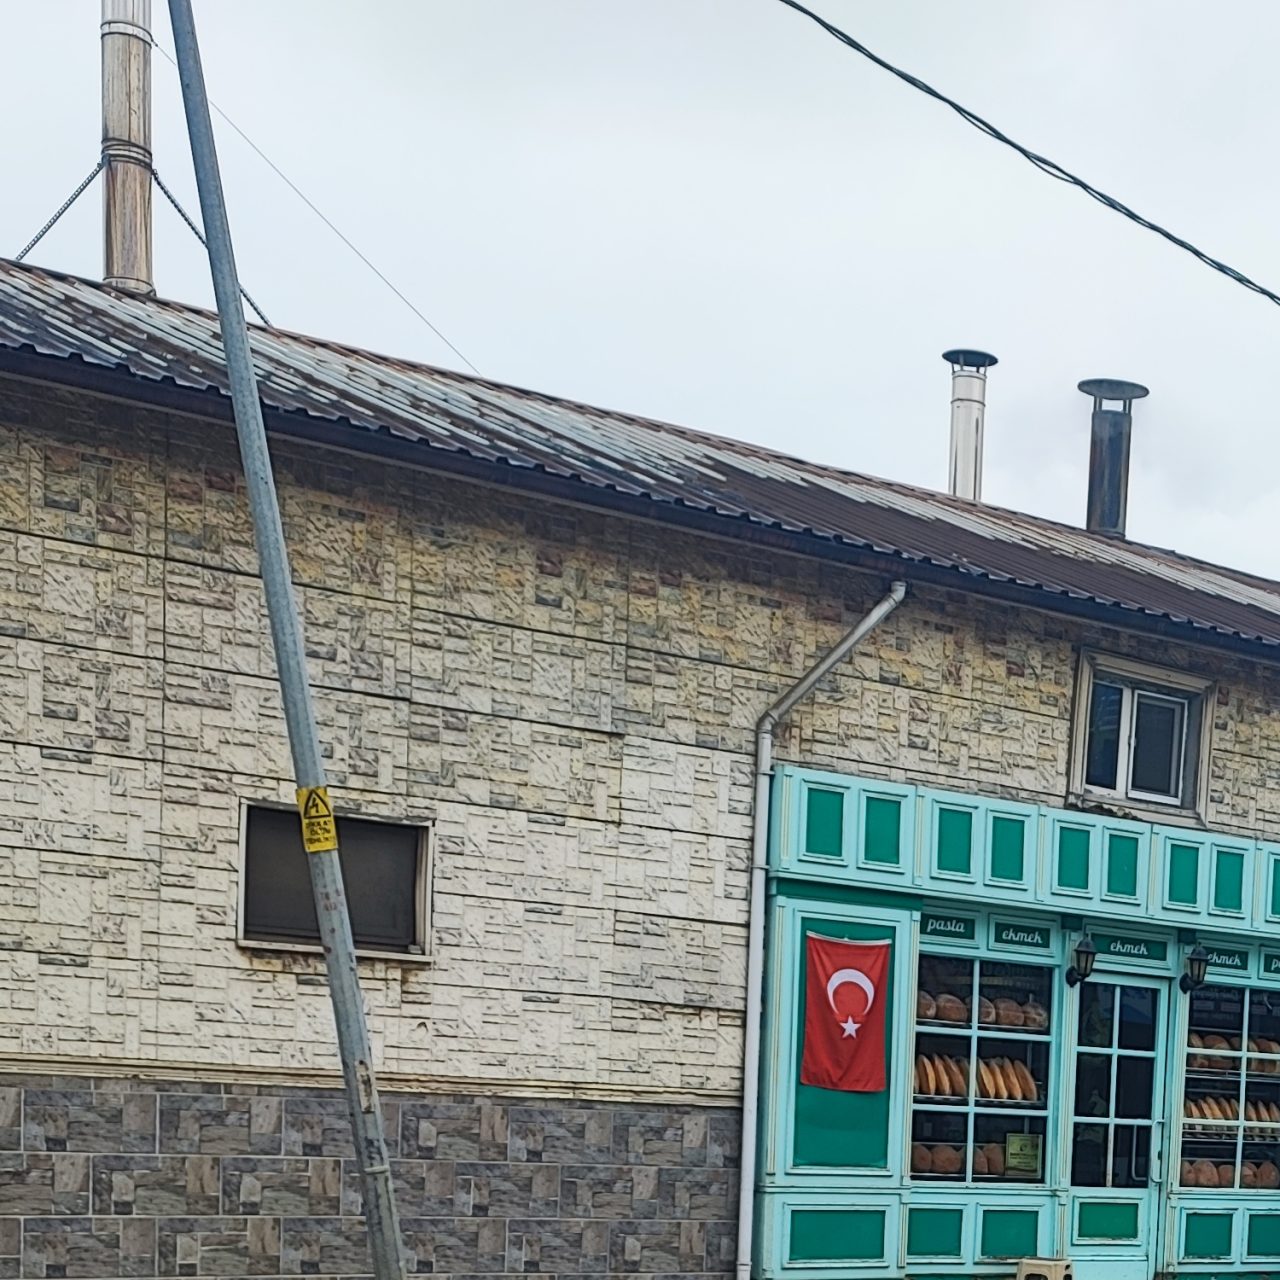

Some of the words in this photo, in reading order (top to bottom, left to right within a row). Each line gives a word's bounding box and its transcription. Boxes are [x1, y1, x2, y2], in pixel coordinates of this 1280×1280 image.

[926, 918, 966, 933] pasta
[1002, 928, 1043, 944] ekmek
[1110, 940, 1149, 955] ekmek
[1207, 951, 1242, 966] ekmek
